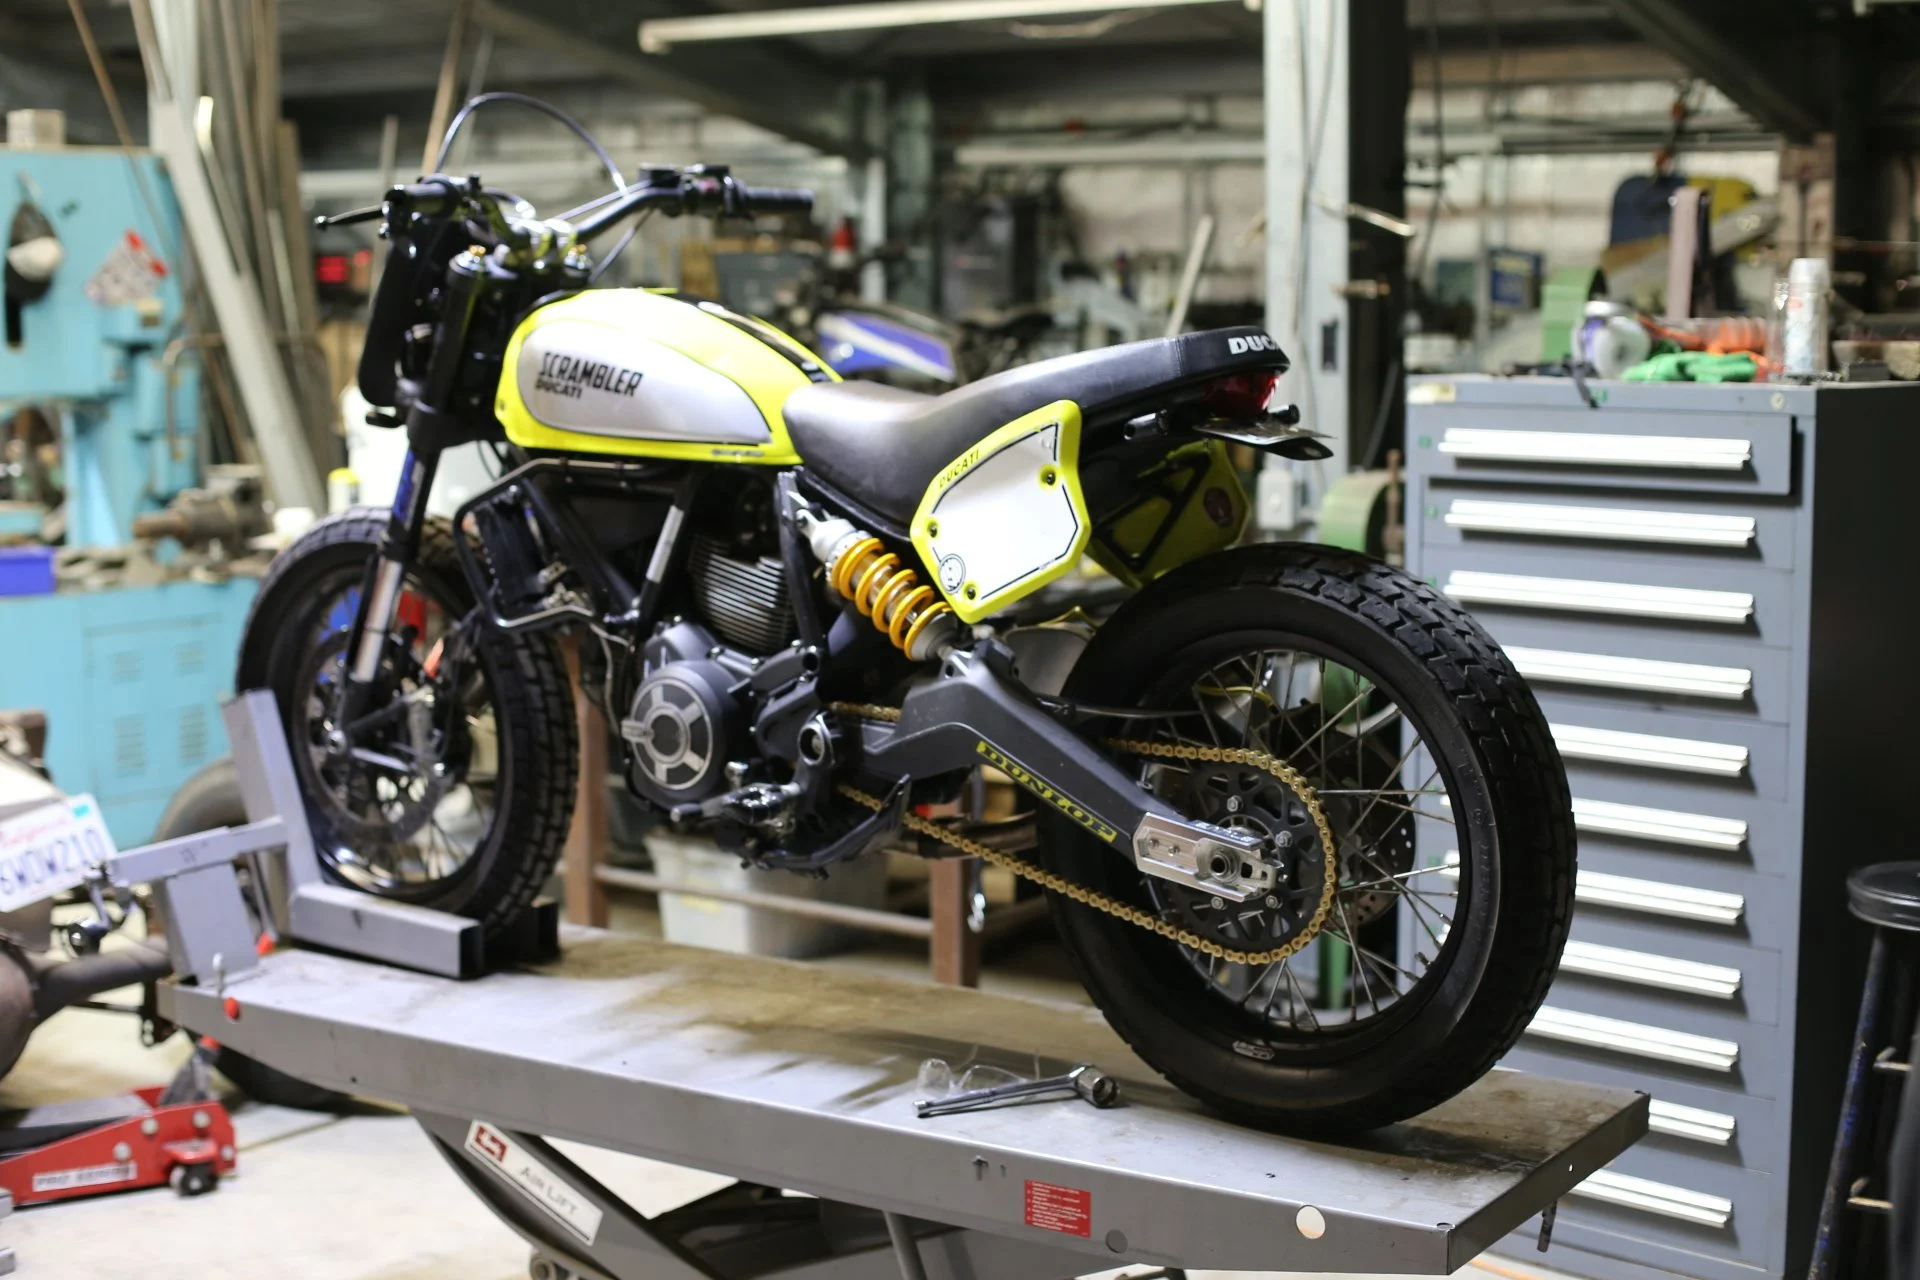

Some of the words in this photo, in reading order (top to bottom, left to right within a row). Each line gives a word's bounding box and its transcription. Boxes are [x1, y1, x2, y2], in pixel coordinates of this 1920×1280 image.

[1228, 334, 1281, 354] DUC
[535, 379, 582, 399] DUCATI
[540, 352, 643, 397] SCRAMBLER
[939, 449, 979, 488] DUCATI
[983, 744, 1115, 838] DUNLOP
